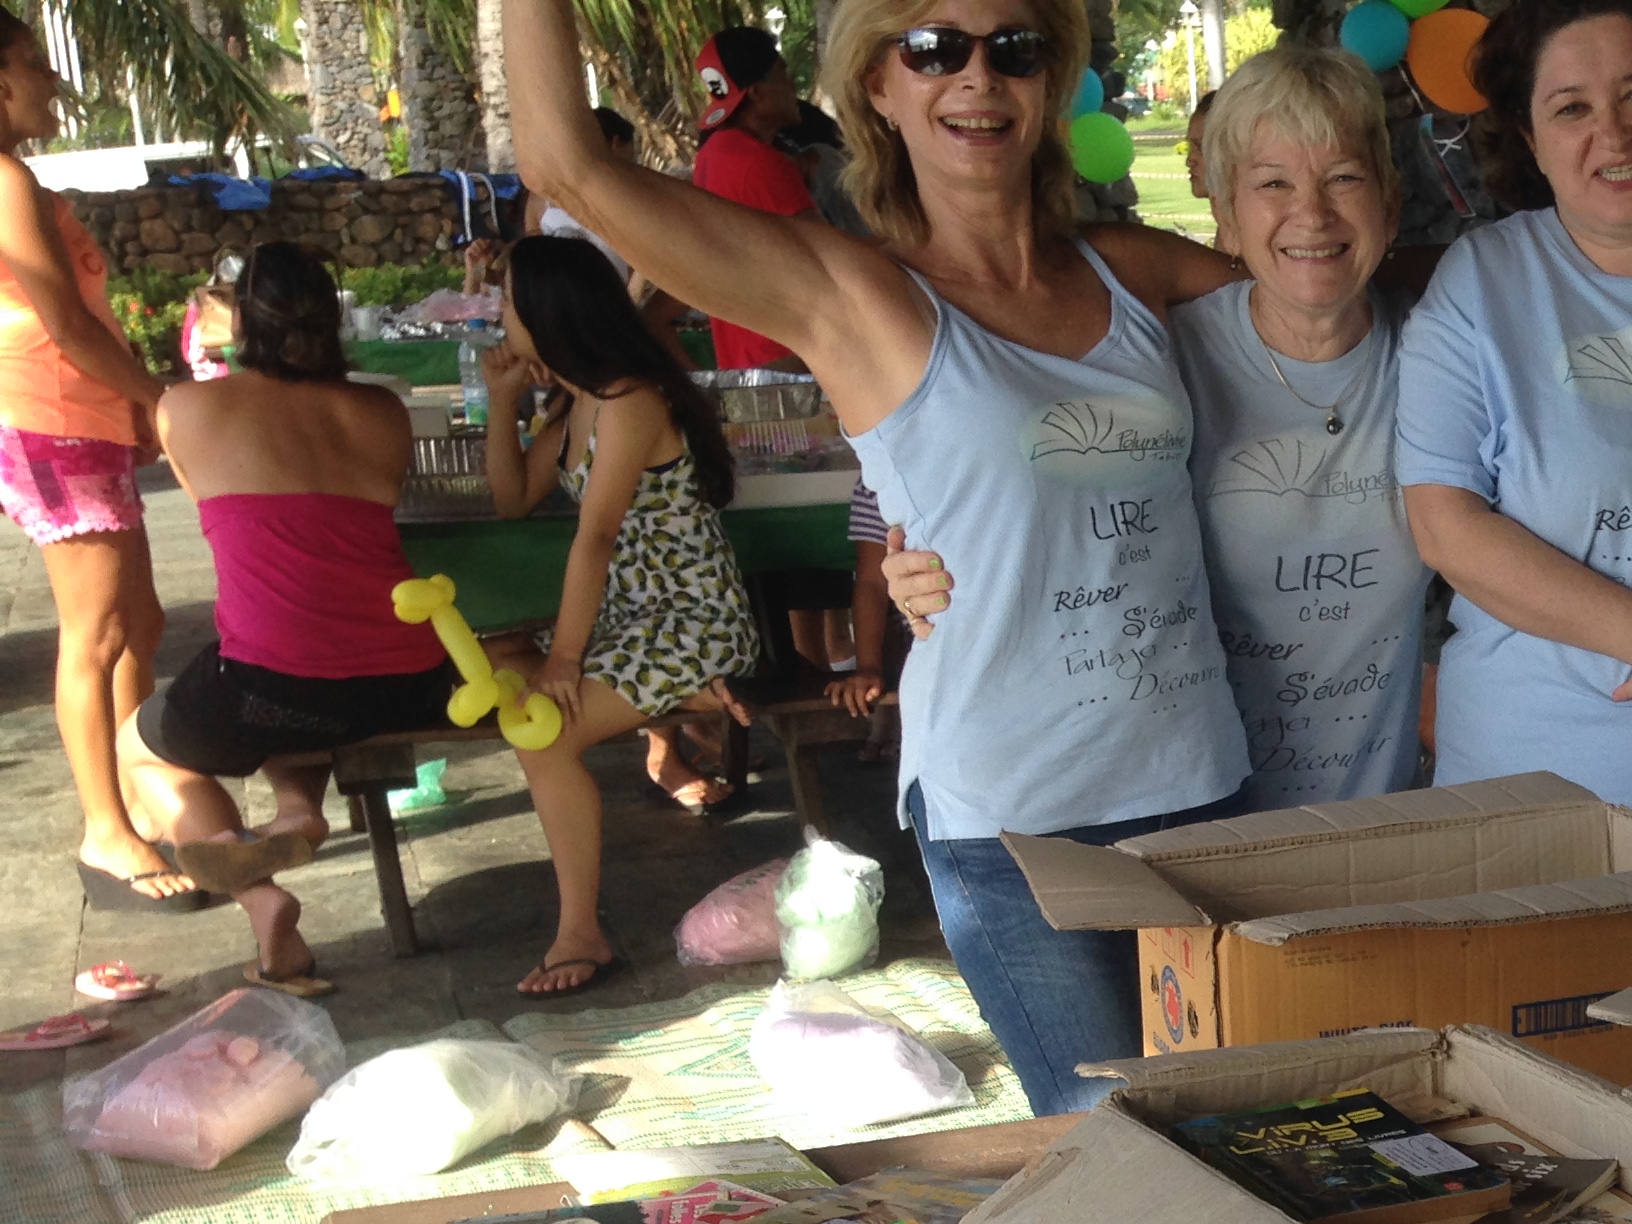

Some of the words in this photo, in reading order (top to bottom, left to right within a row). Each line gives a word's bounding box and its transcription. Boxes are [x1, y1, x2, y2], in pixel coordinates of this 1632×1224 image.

[1090, 500, 1159, 540] LIRE
[1118, 543, 1152, 565] c'est
[1274, 549, 1380, 592] LIRE
[1054, 582, 1128, 612] Rêver
[1299, 598, 1351, 621] c'est
